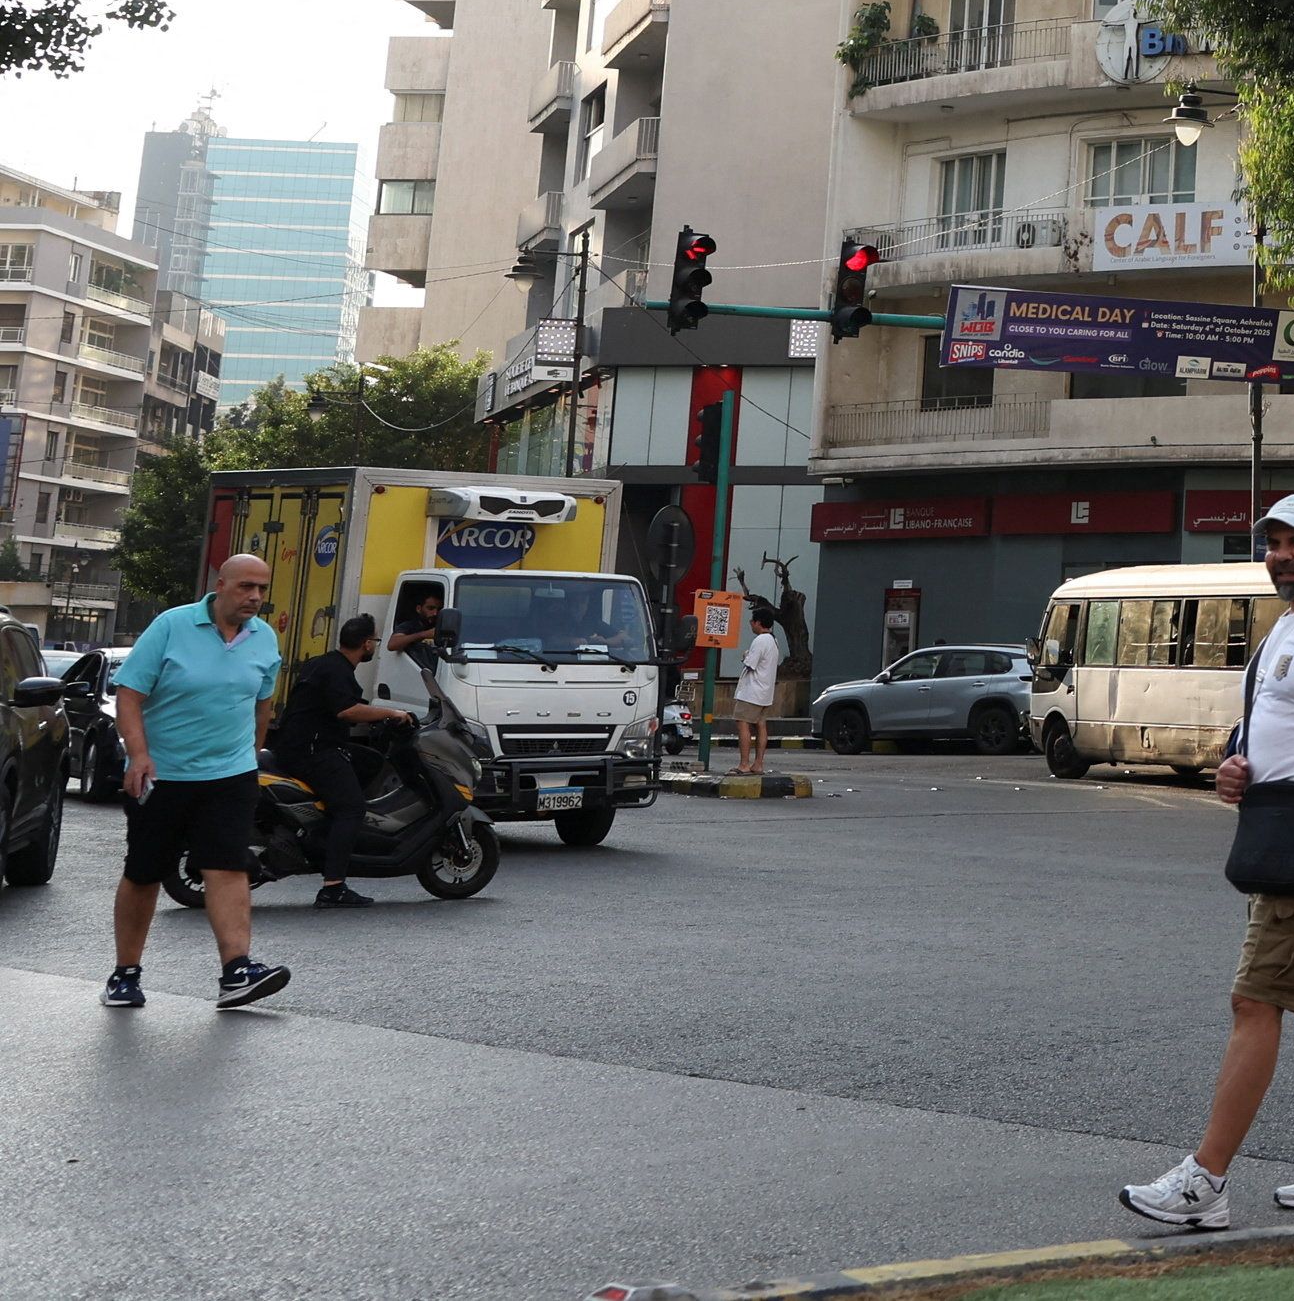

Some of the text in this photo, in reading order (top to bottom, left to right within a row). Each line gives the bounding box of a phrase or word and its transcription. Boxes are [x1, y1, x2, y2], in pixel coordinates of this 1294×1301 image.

[1104, 209, 1224, 258] CALF
[1009, 302, 1135, 323] MEDICAL DAY
[1151, 312, 1273, 327] Location: Sassine Square, Achrafieh
[1008, 324, 1129, 338] CLOSE TO YOU CARING FOR ALL
[1172, 323, 1203, 332] Saturday
[1224, 326, 1253, 335] October
[1185, 332, 1205, 341] 10:00
[1225, 335, 1242, 343] 5:00
[988, 348, 1025, 358] candia
[905, 506, 935, 517] BANQUE
[438, 520, 533, 549] ARCOR
[315, 538, 338, 555] ARCOR
[624, 693, 635, 704] 15
[538, 795, 583, 810] M319962
